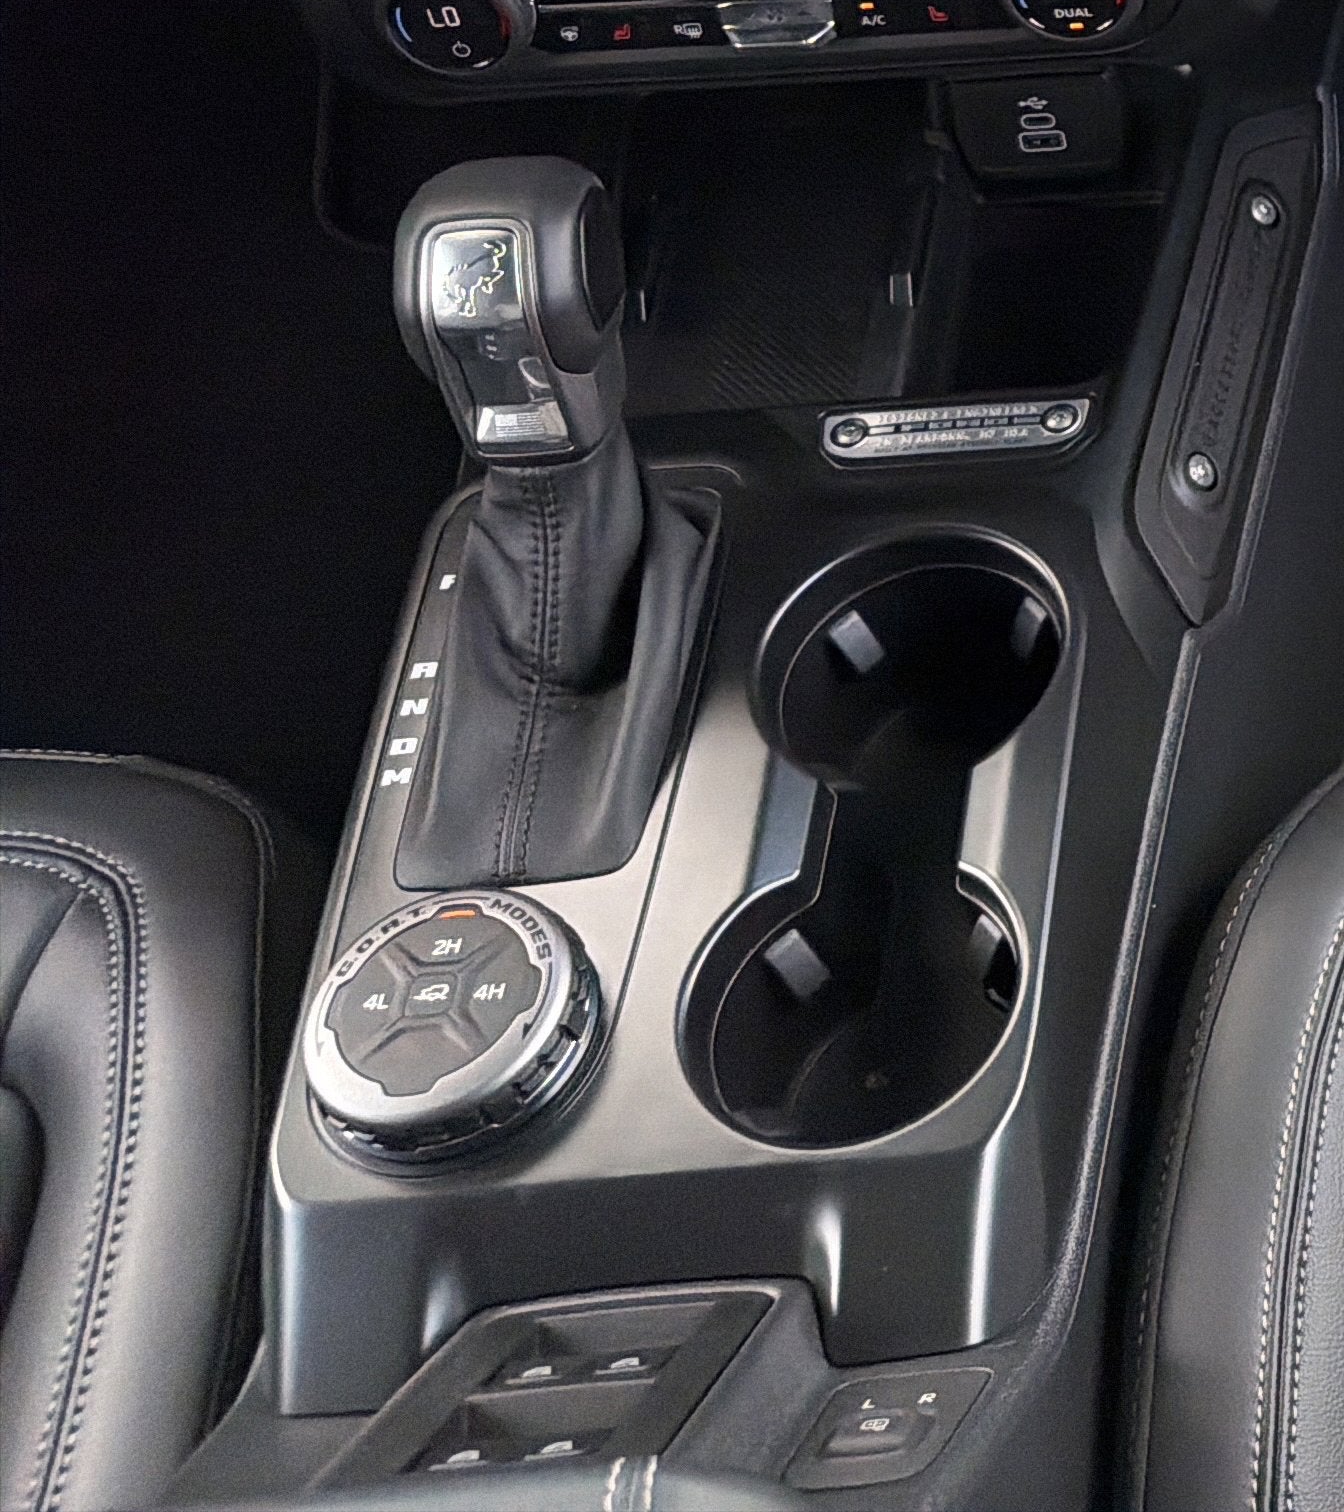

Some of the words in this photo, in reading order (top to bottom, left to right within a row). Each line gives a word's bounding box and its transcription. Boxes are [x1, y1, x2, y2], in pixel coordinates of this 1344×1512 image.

[861, 14, 887, 26] A/C
[1053, 7, 1094, 20] DUAL
[399, 697, 429, 717] N
[380, 767, 412, 787] M
[488, 898, 553, 962] MODES
[431, 938, 463, 956] 2H
[472, 982, 507, 1001] 4H
[362, 992, 389, 1011] 4L
[861, 1398, 876, 1410] L
[917, 1392, 937, 1405] R
